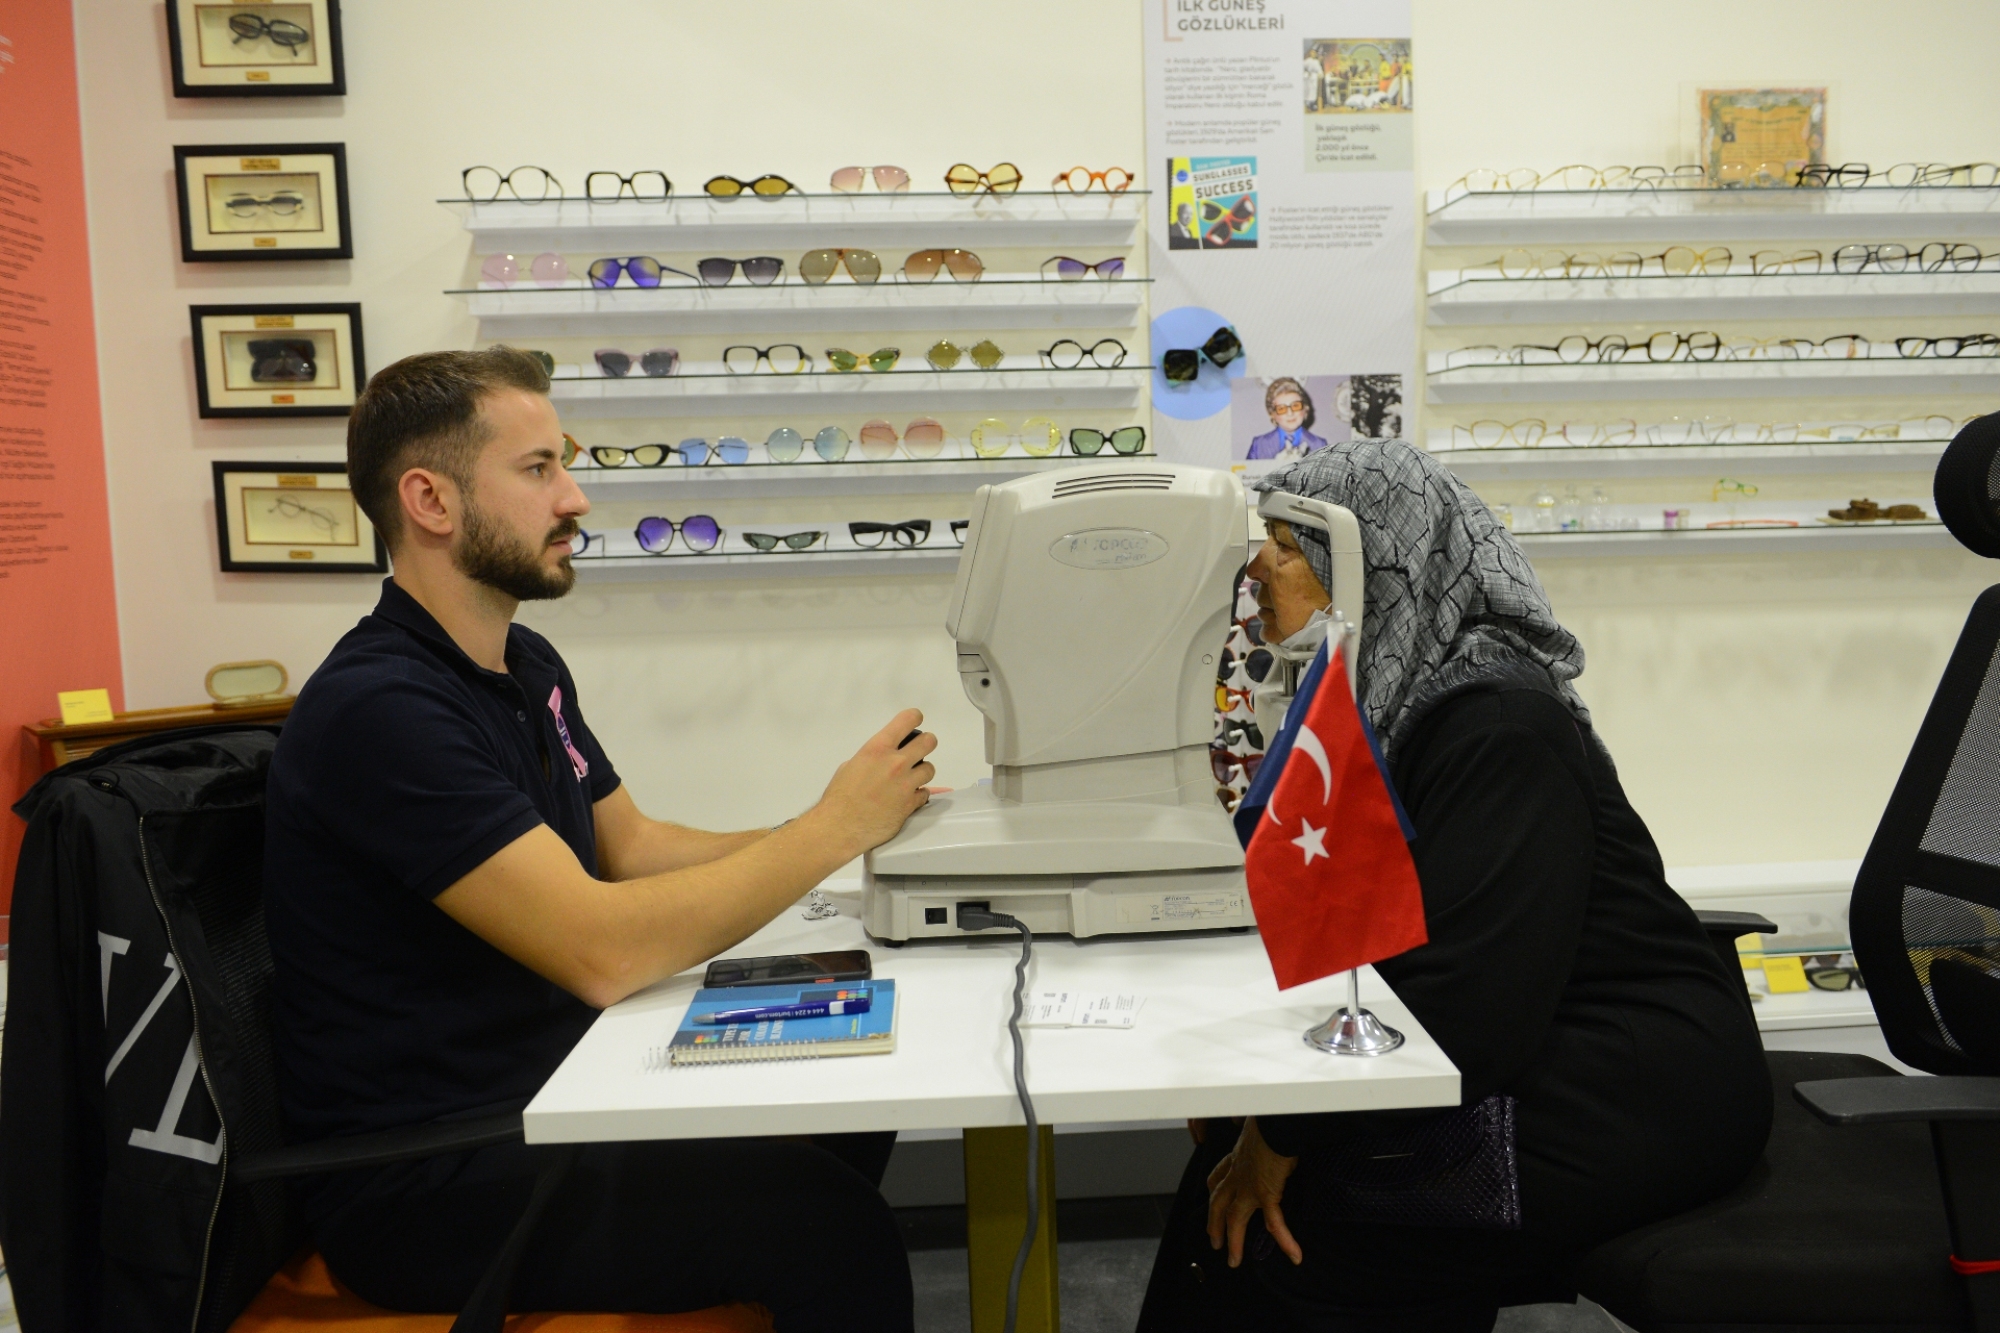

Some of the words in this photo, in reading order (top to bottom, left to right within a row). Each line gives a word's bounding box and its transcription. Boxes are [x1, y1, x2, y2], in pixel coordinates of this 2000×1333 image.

[1177, 14, 1285, 31] GÖZLÜKLERİ
[1193, 165, 1249, 182] SUNGLASSES
[1195, 179, 1254, 199] SUCCESS
